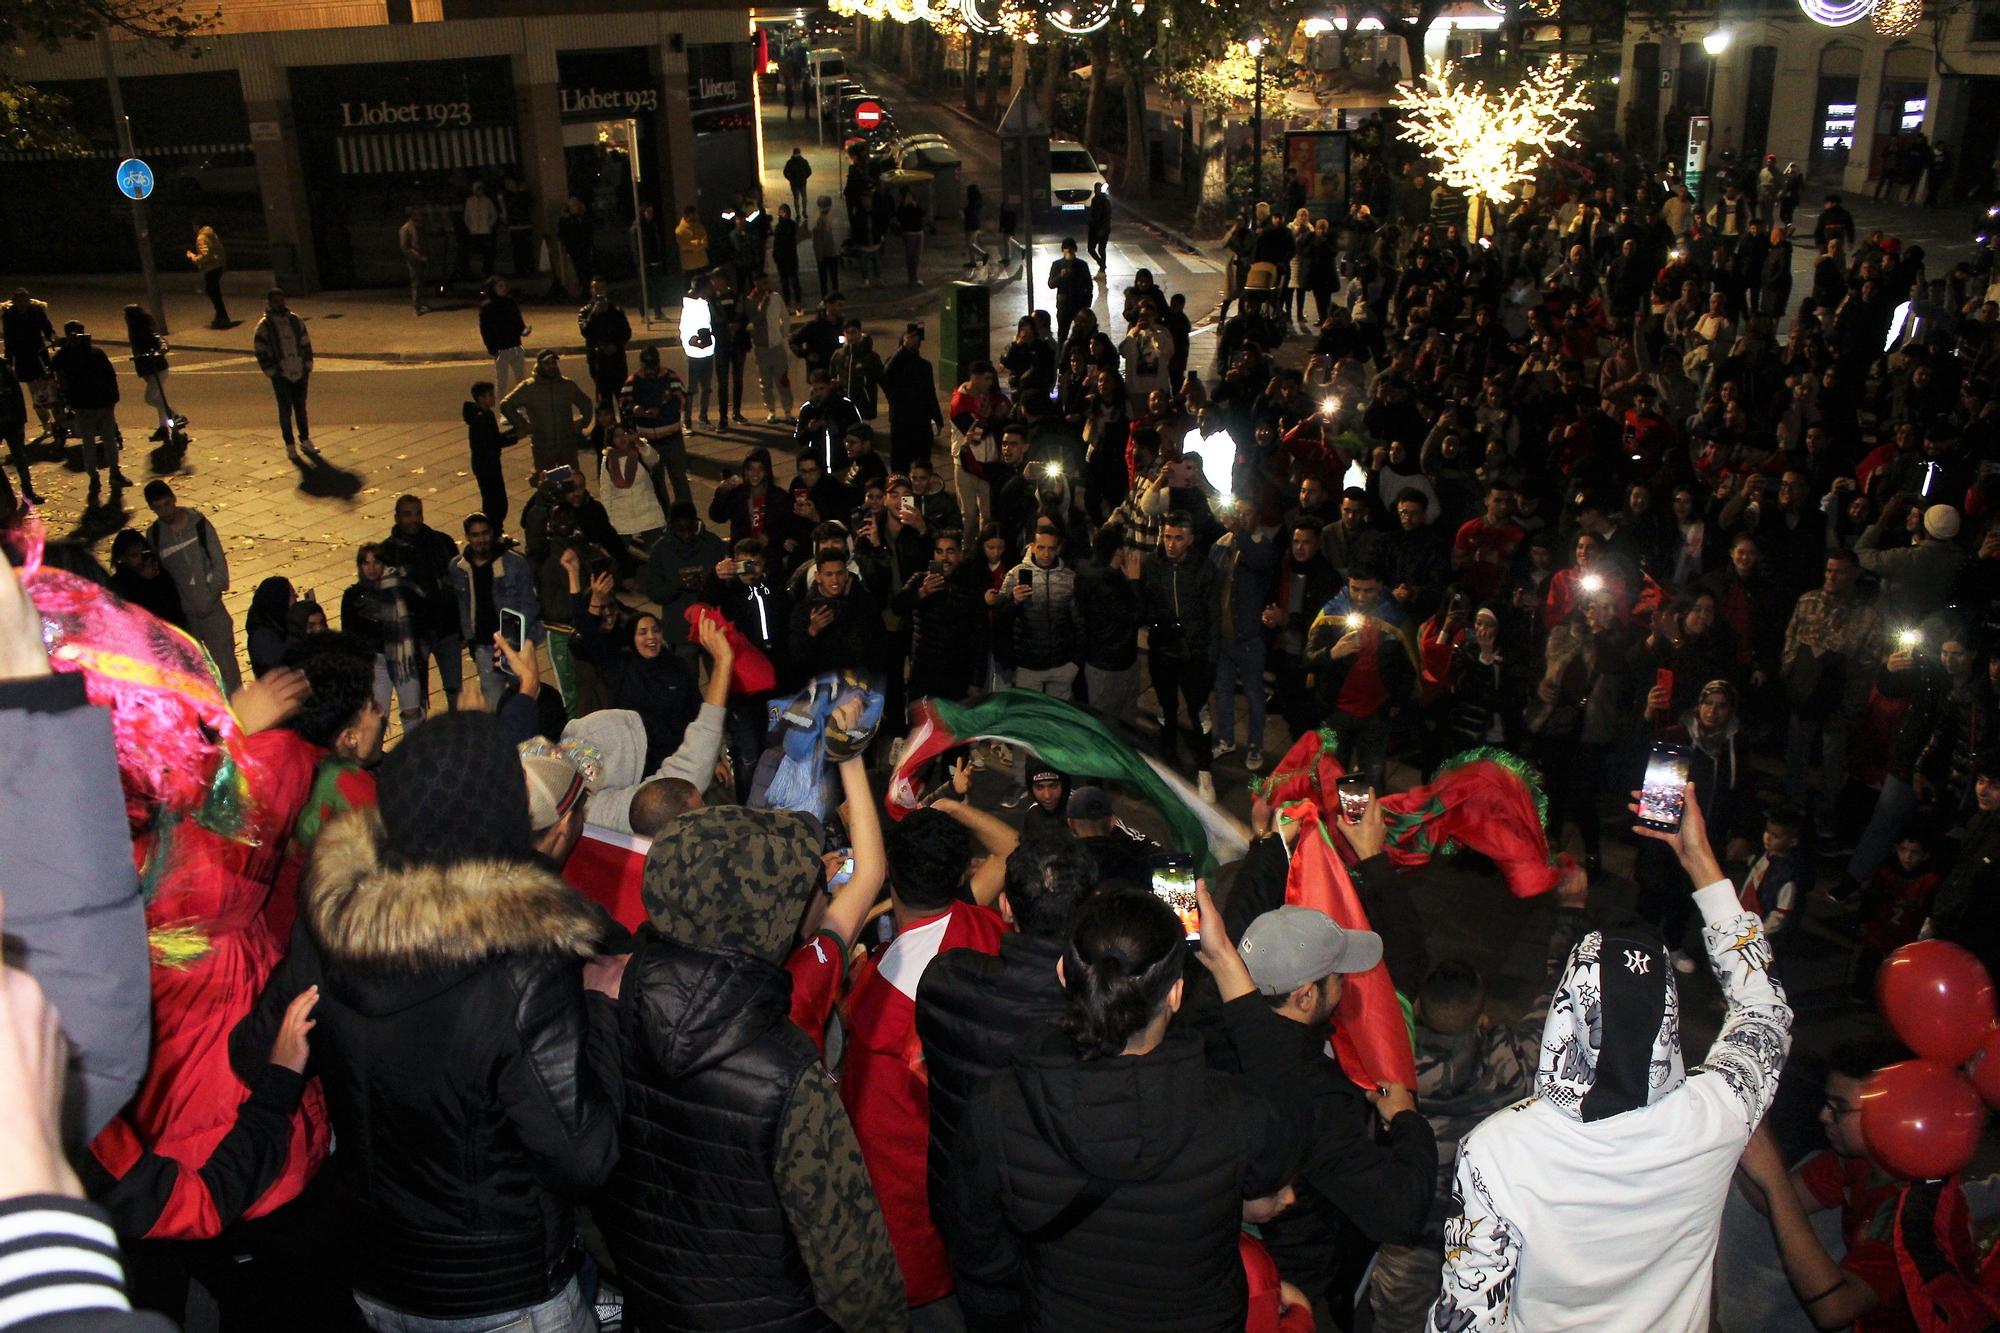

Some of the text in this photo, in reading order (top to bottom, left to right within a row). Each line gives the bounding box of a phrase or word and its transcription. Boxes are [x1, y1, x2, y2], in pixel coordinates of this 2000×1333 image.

[560, 88, 657, 113] Llobet 1923
[340, 100, 473, 128] Llobet 1923
